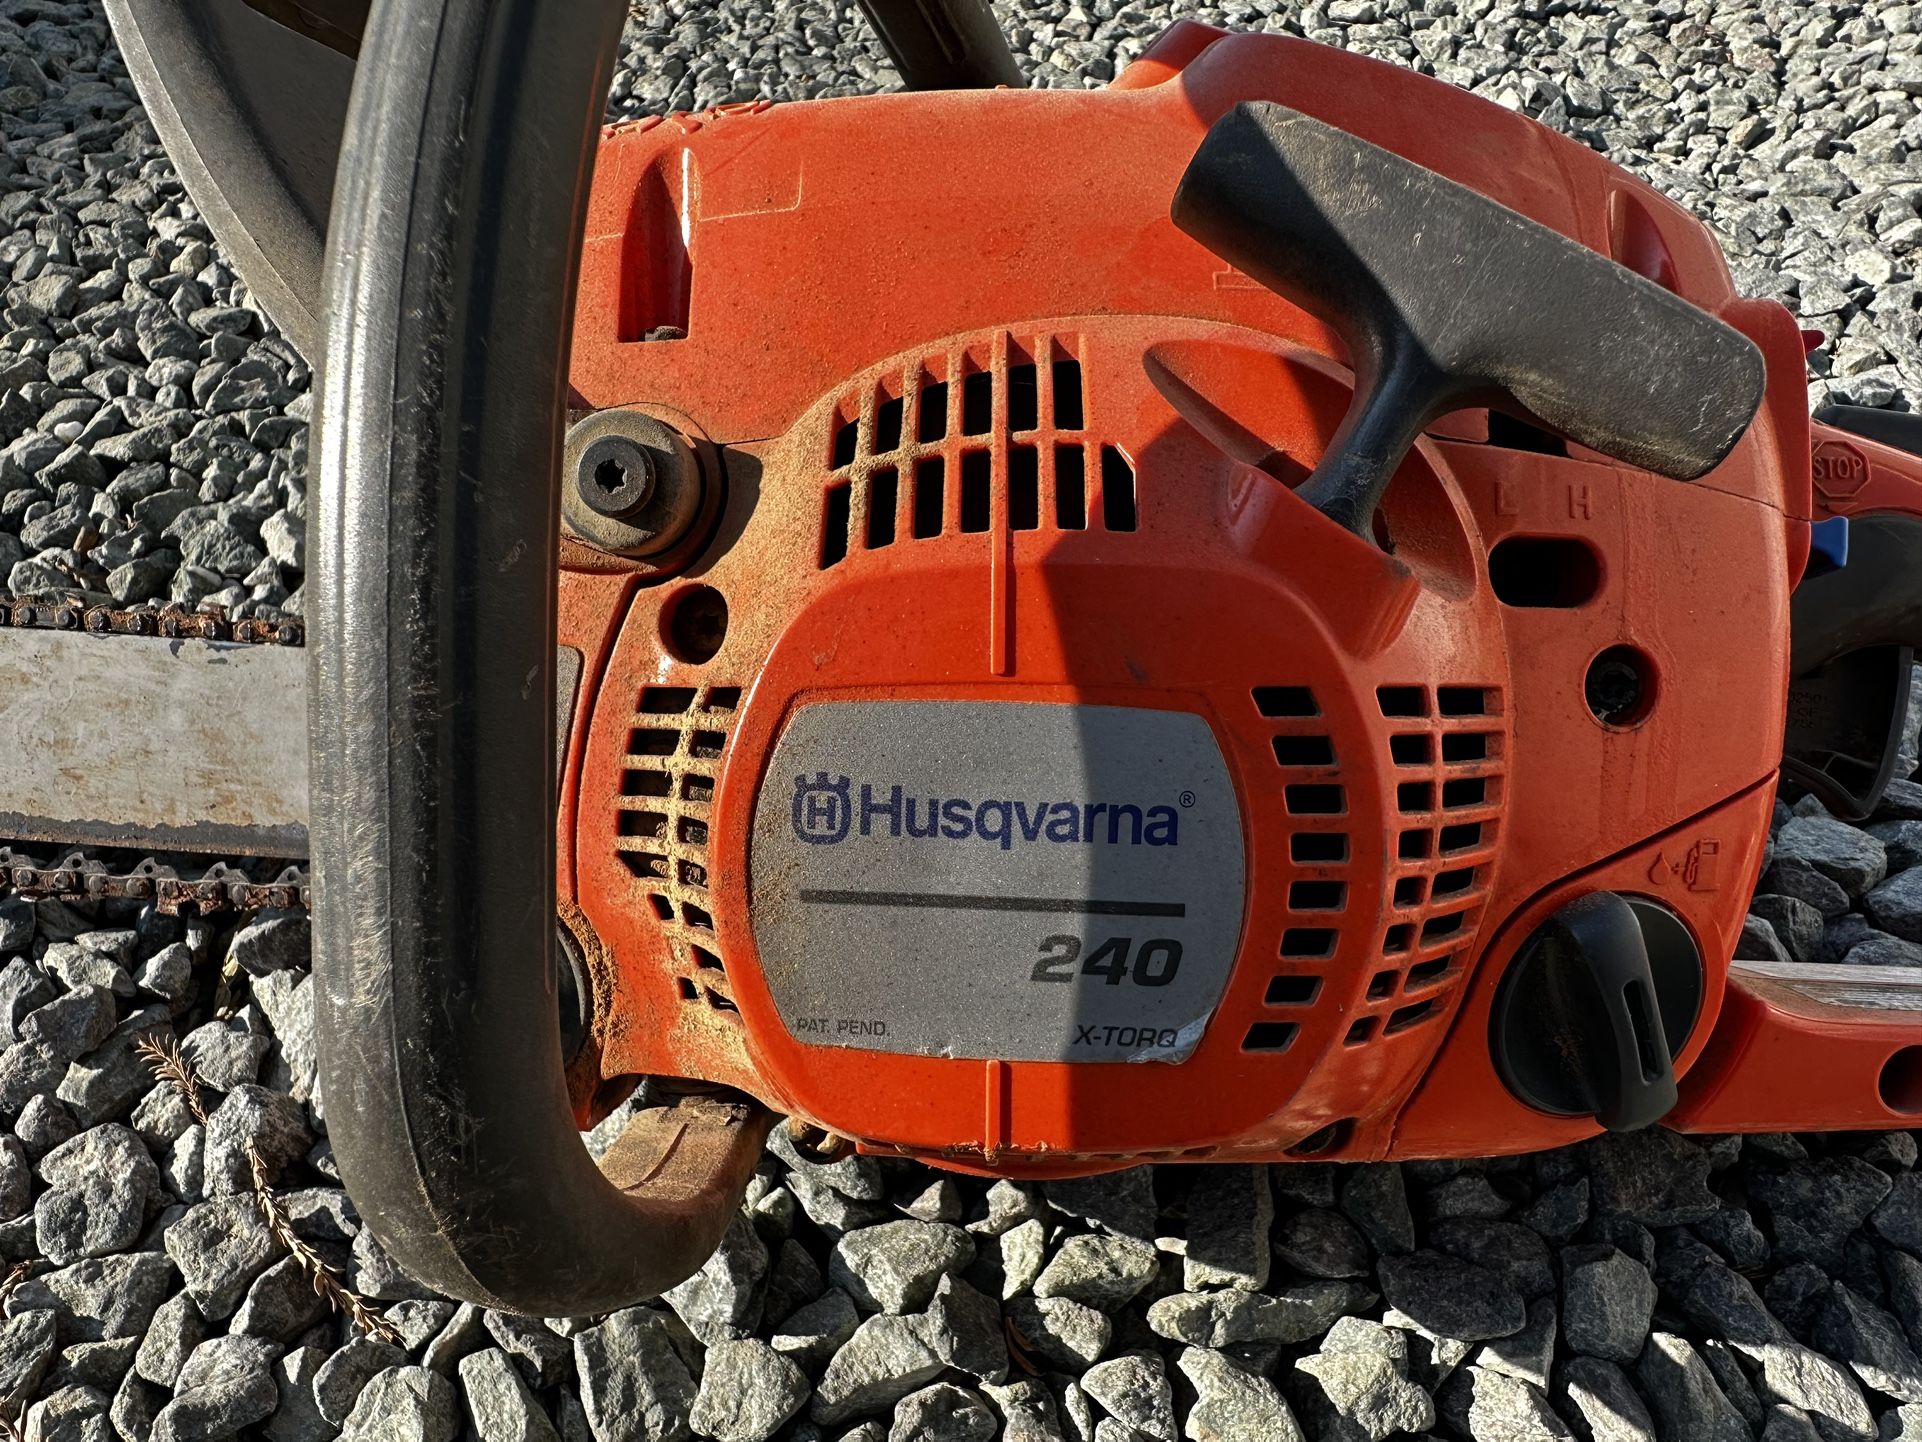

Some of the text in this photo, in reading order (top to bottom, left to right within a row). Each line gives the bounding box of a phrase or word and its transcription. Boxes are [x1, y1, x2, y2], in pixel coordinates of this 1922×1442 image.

[1813, 456, 1863, 478] STOP
[1494, 480, 1592, 520] L H
[1030, 933, 1183, 987] 240
[796, 1017, 891, 1037] PAT. PEND.
[1072, 1024, 1179, 1048] X-TORQ
